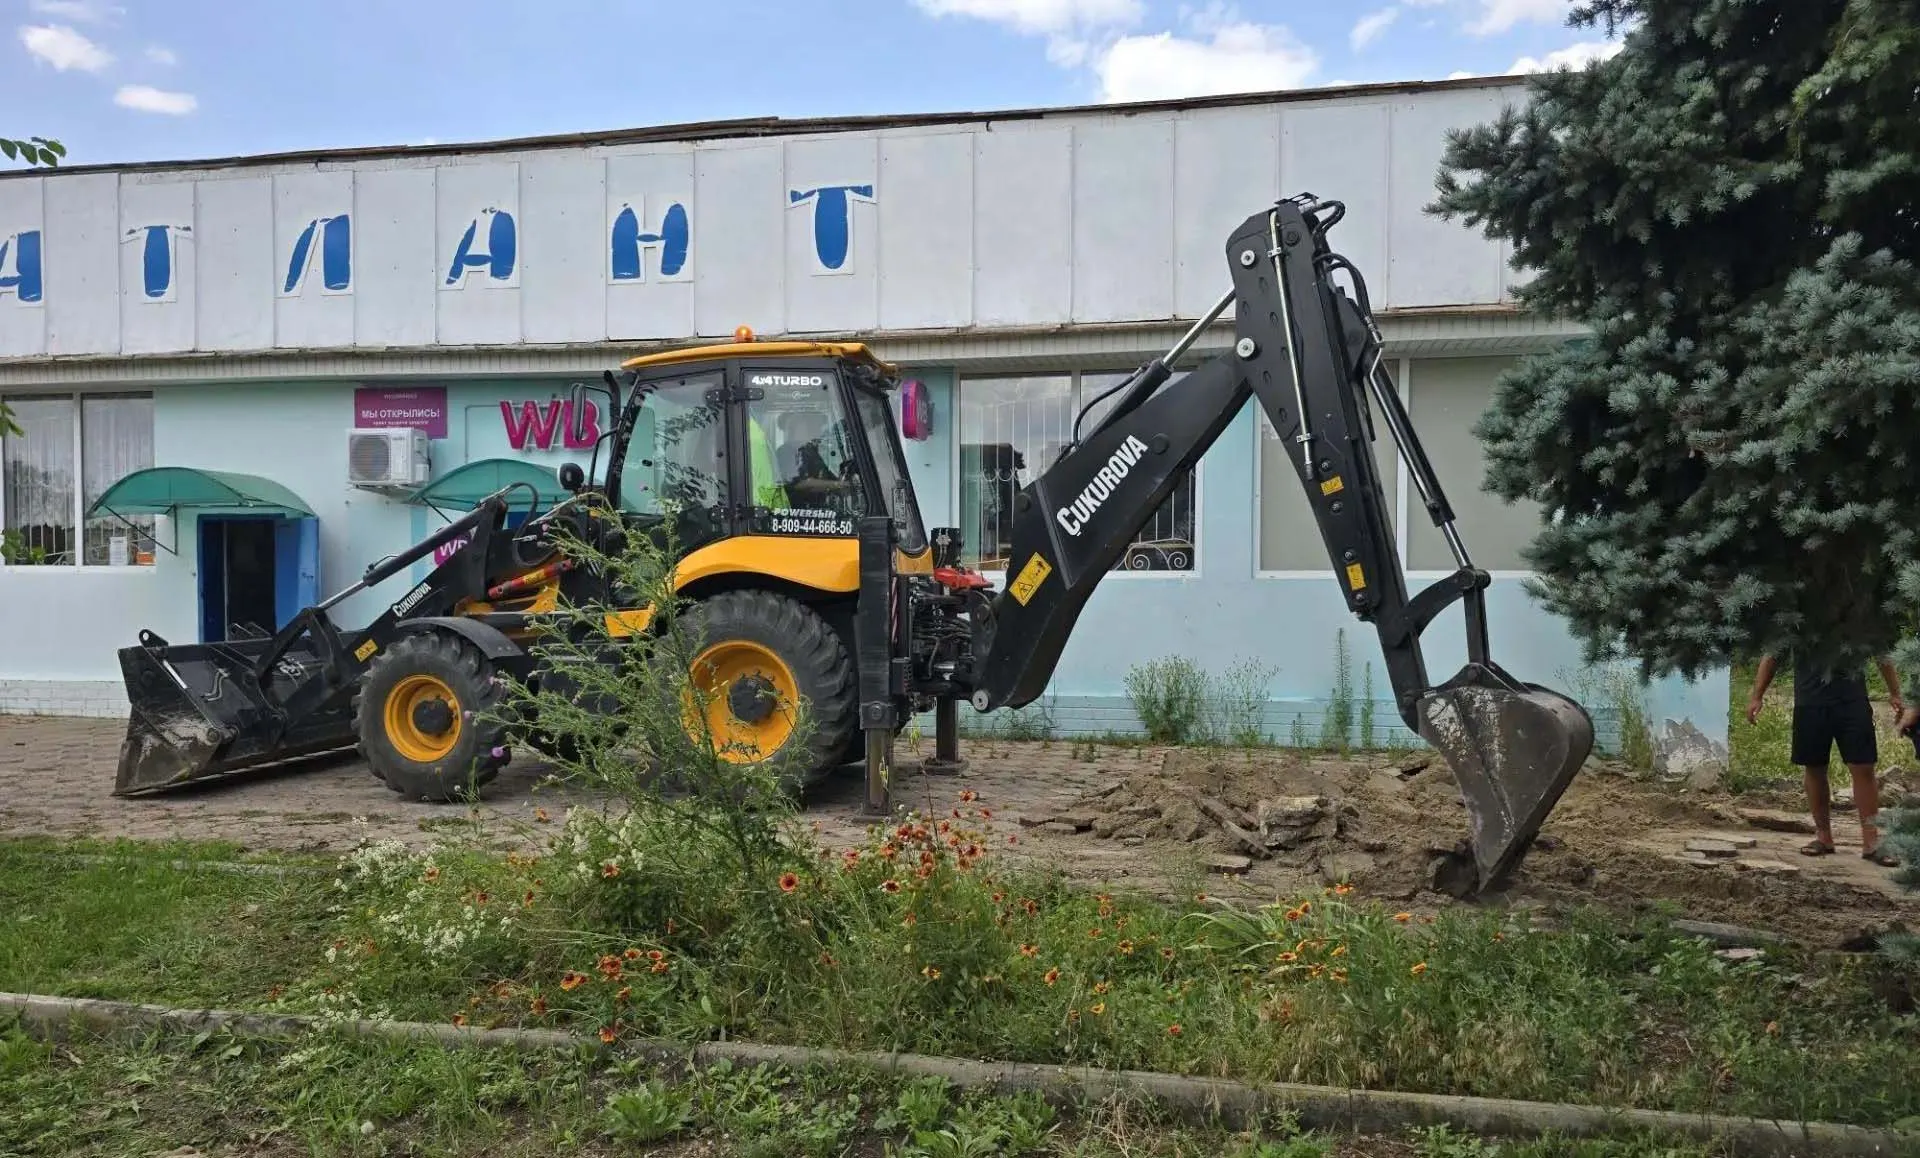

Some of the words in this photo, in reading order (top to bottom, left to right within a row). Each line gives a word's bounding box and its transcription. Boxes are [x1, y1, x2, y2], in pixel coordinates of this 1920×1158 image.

[361, 410, 378, 419] МЫ
[379, 408, 440, 419] ОТКРЫЛИСЬ!
[500, 400, 600, 450] WB
[1056, 434, 1149, 536] ÇUKUROVA
[772, 518, 852, 535] 8-909-44-666-50
